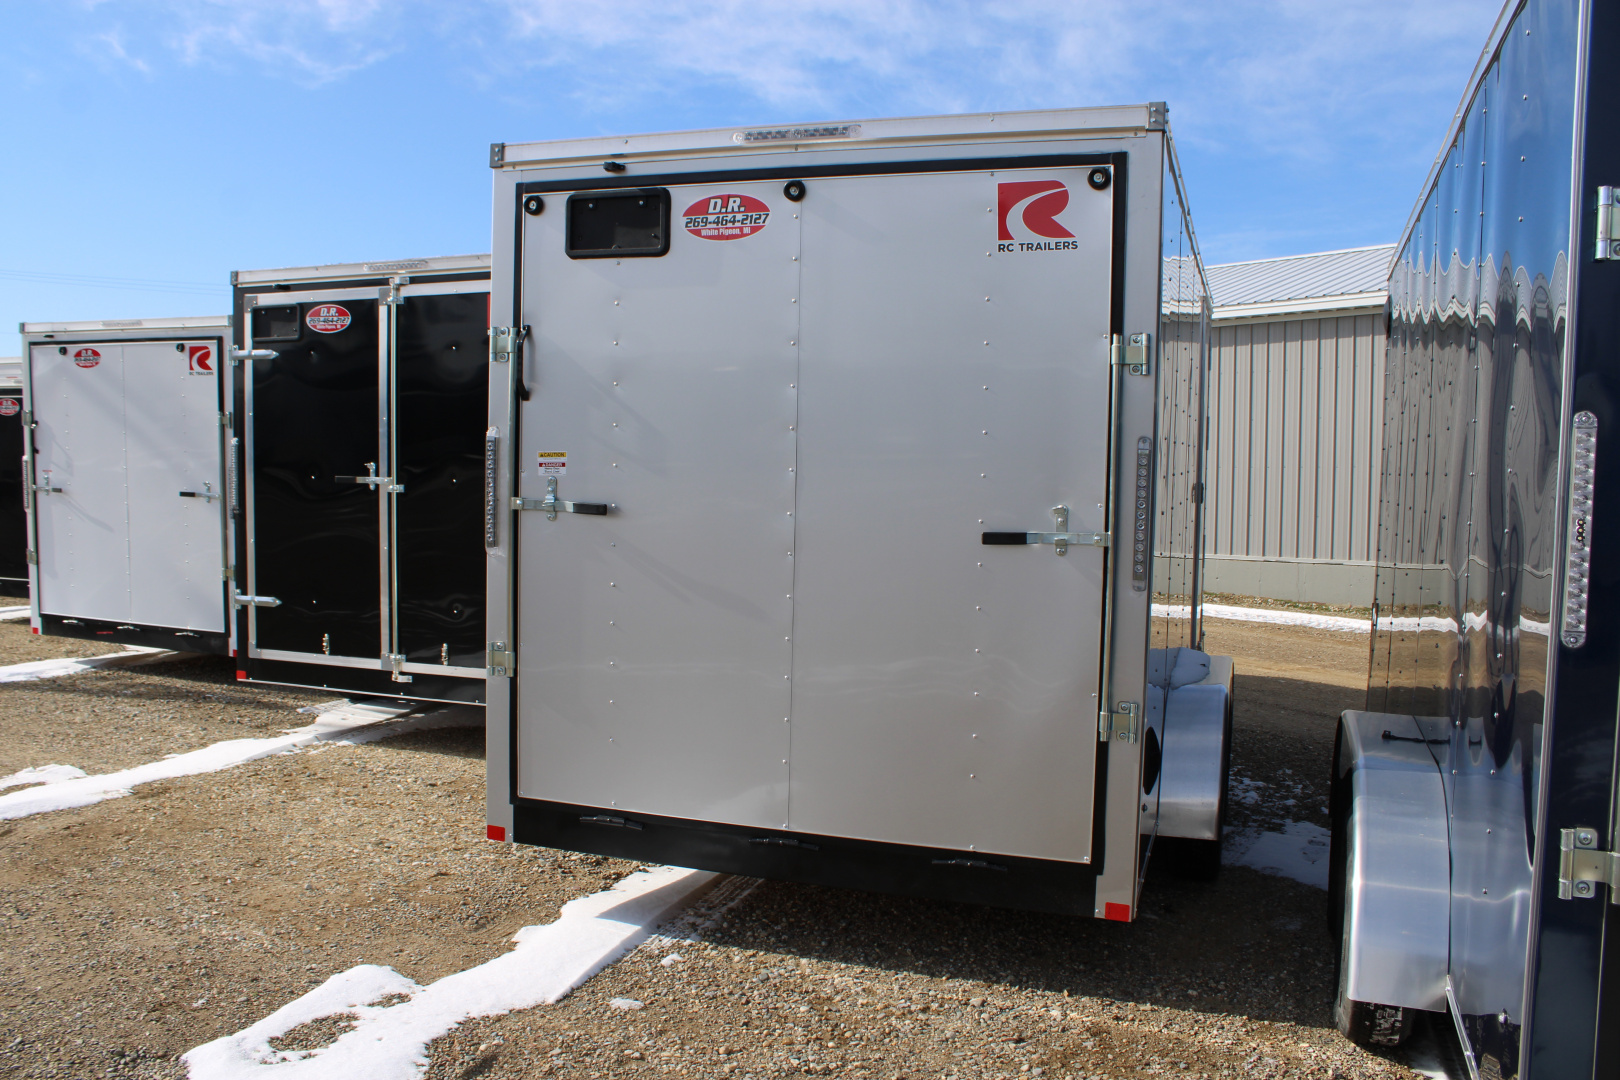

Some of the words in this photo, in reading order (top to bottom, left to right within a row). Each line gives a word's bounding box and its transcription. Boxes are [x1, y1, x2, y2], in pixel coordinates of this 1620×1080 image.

[707, 196, 746, 214] D.R.
[685, 212, 770, 229] 269-464-2127
[701, 228, 718, 236] White
[719, 227, 741, 236] Pigeon,
[743, 226, 751, 234] MI
[998, 242, 1015, 252] RC
[1018, 240, 1079, 252] TRAILERS
[320, 307, 339, 316] D.R.
